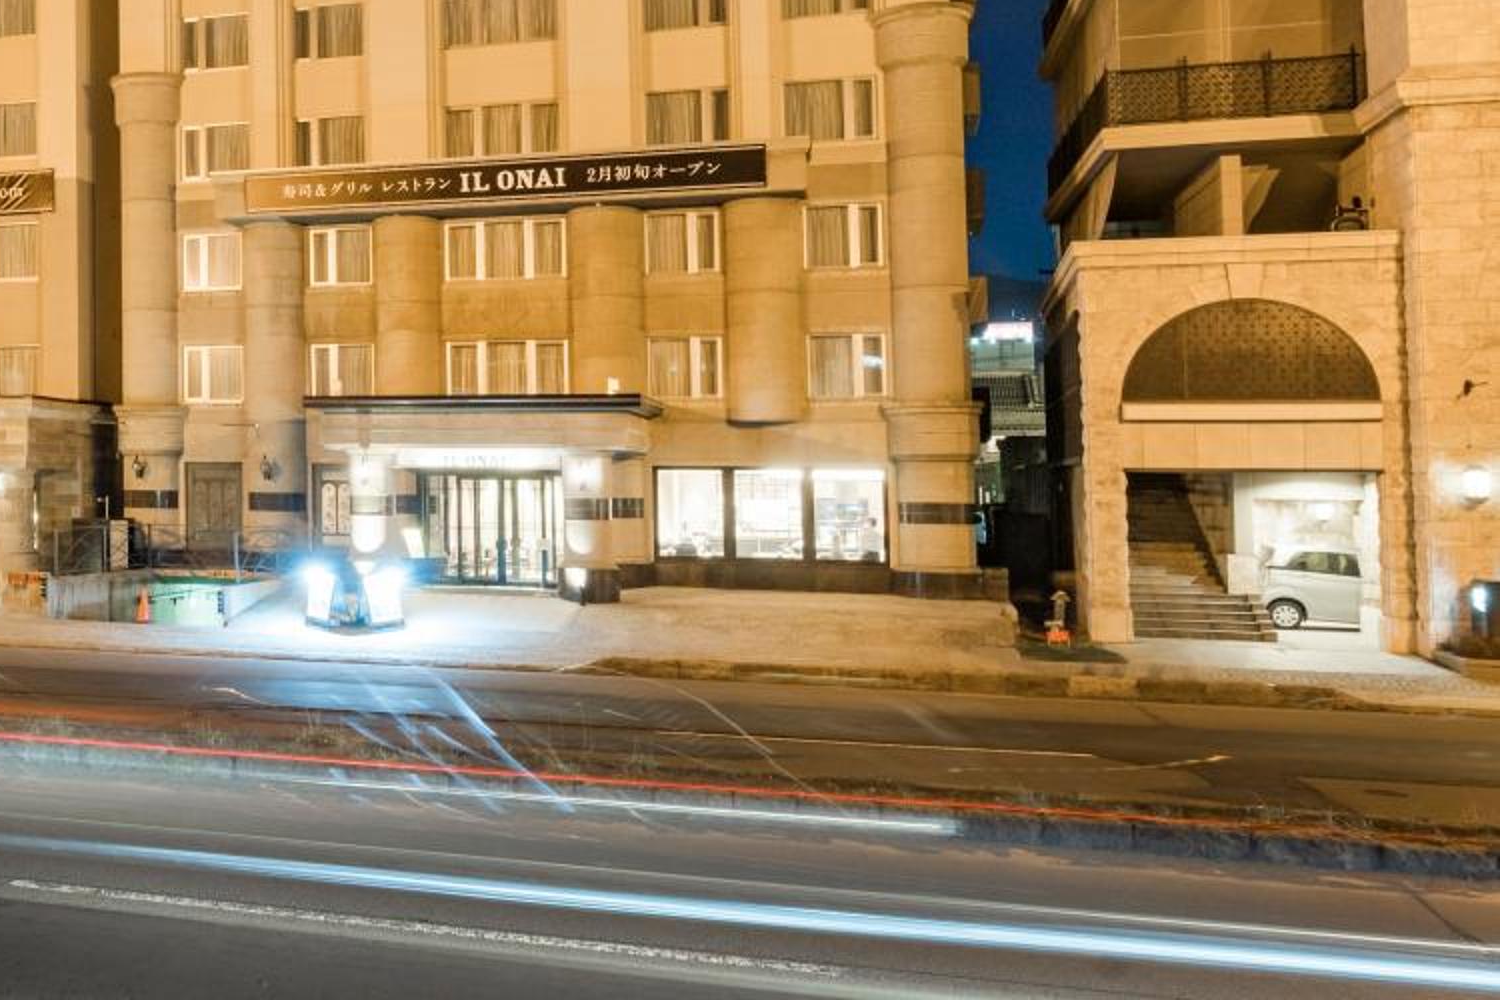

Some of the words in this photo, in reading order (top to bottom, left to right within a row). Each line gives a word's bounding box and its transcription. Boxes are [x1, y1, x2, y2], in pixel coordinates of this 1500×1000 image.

[381, 177, 451, 193] レストラン
[460, 171, 490, 193] IL
[496, 167, 568, 190] ONAI
[587, 160, 722, 183] 2月初旬オープン
